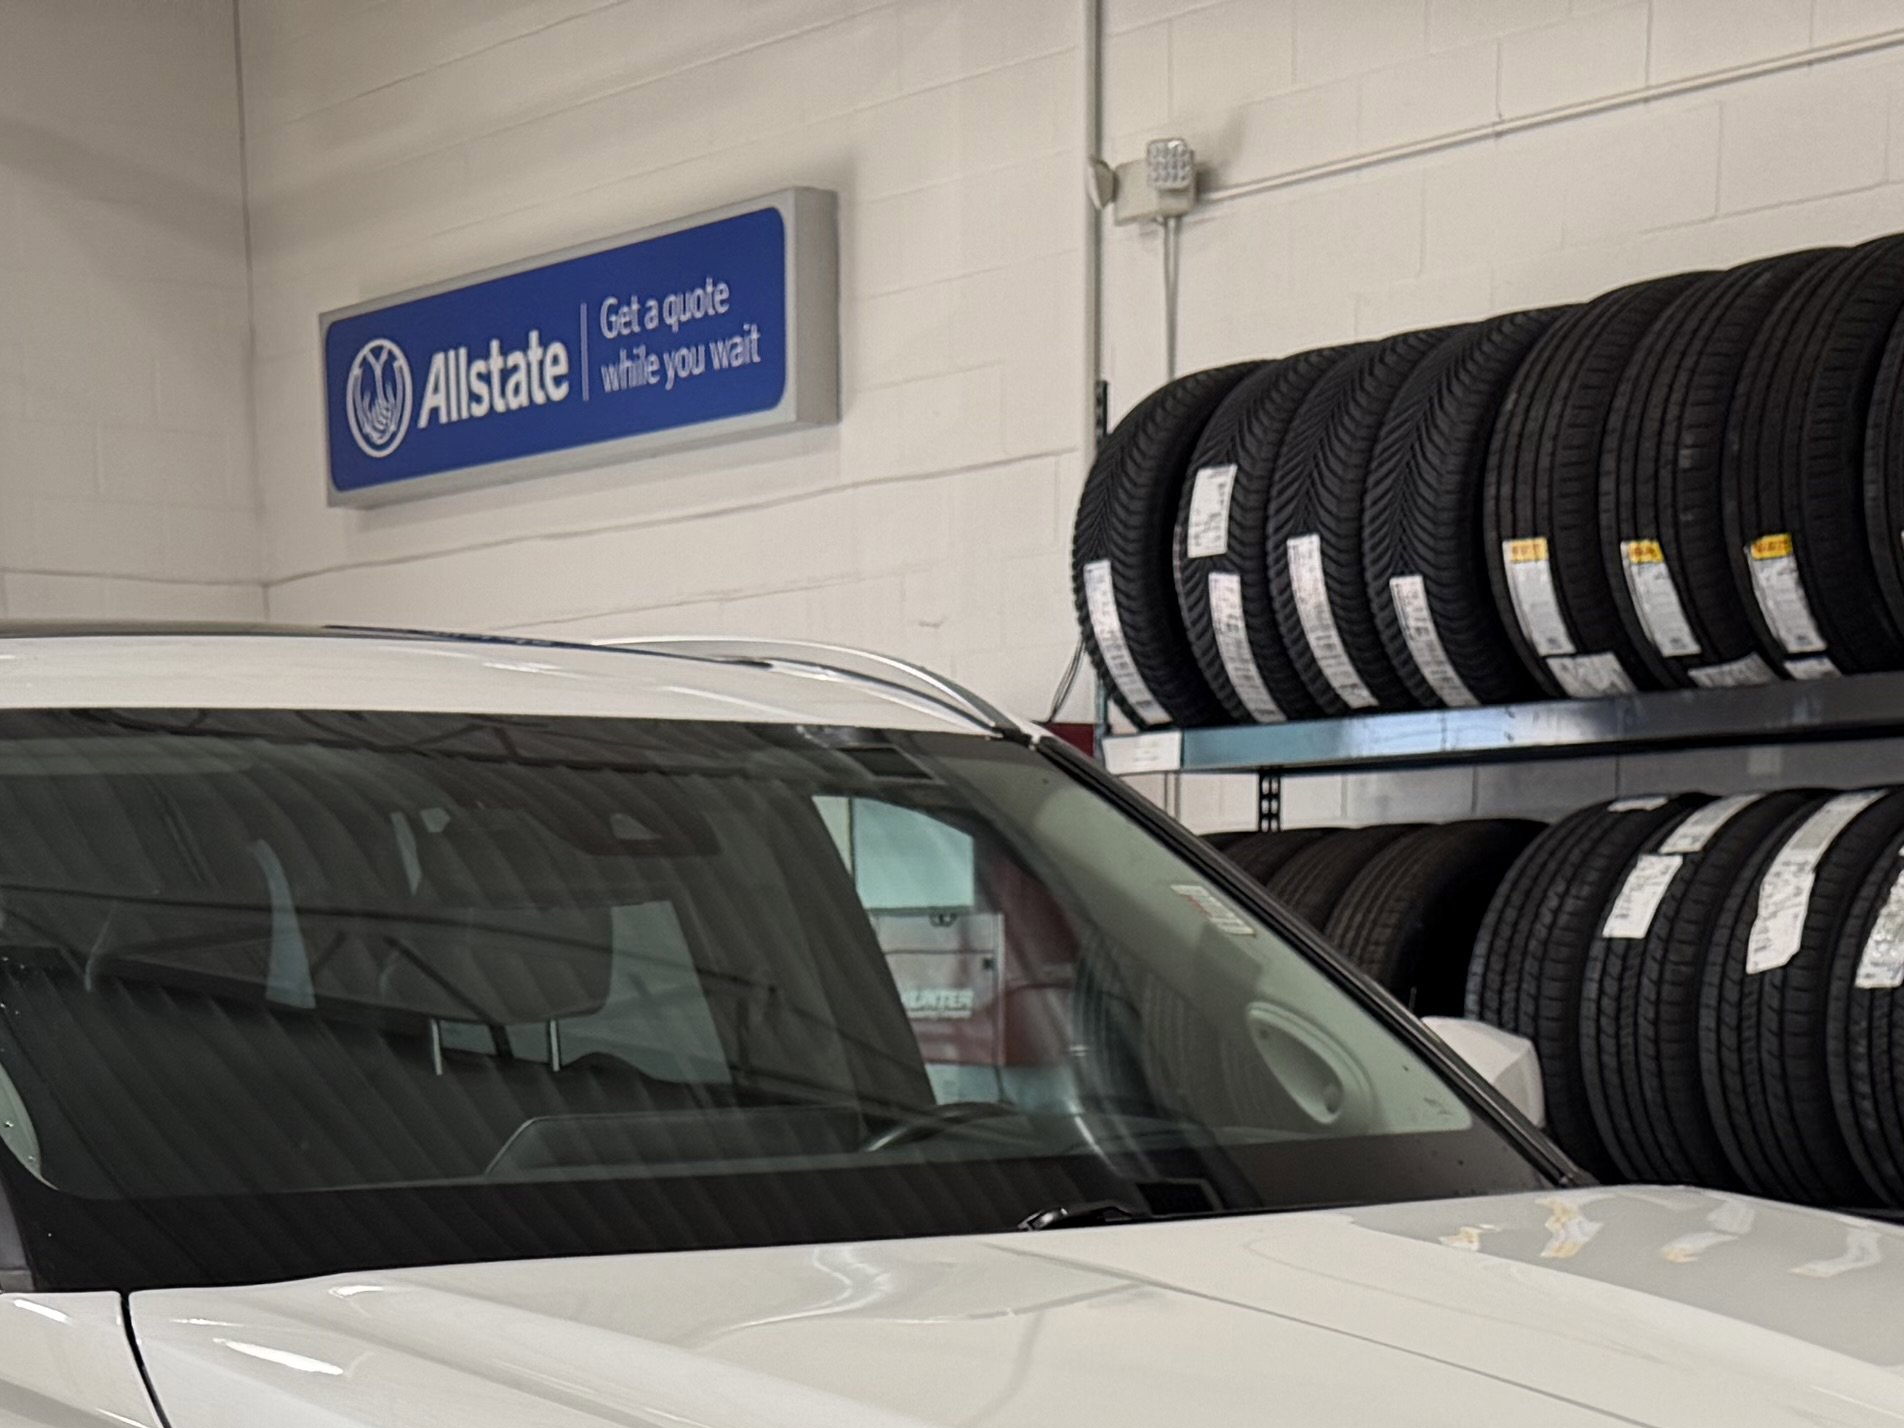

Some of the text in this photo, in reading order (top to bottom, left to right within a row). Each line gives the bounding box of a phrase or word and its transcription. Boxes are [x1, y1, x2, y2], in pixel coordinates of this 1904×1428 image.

[599, 277, 730, 340] Get a quote
[417, 328, 571, 430] Allstate
[601, 322, 762, 393] while you wait
